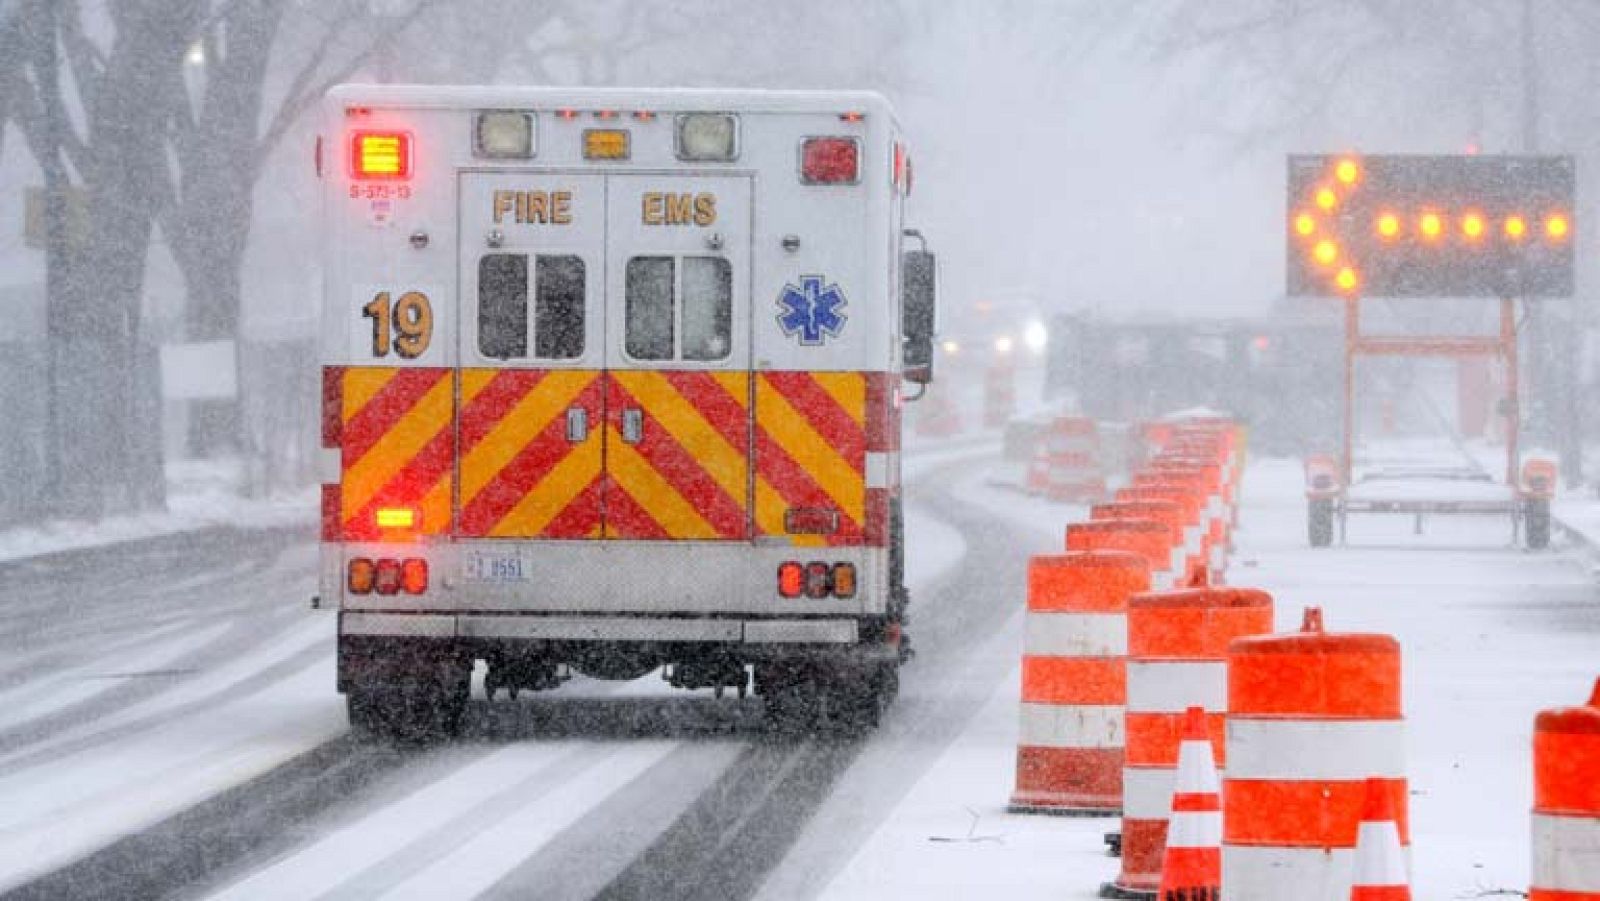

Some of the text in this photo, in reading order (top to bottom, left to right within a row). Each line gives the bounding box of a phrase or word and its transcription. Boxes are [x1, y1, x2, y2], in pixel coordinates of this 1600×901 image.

[494, 189, 718, 227] FIRE EMS
[362, 291, 434, 359] 19
